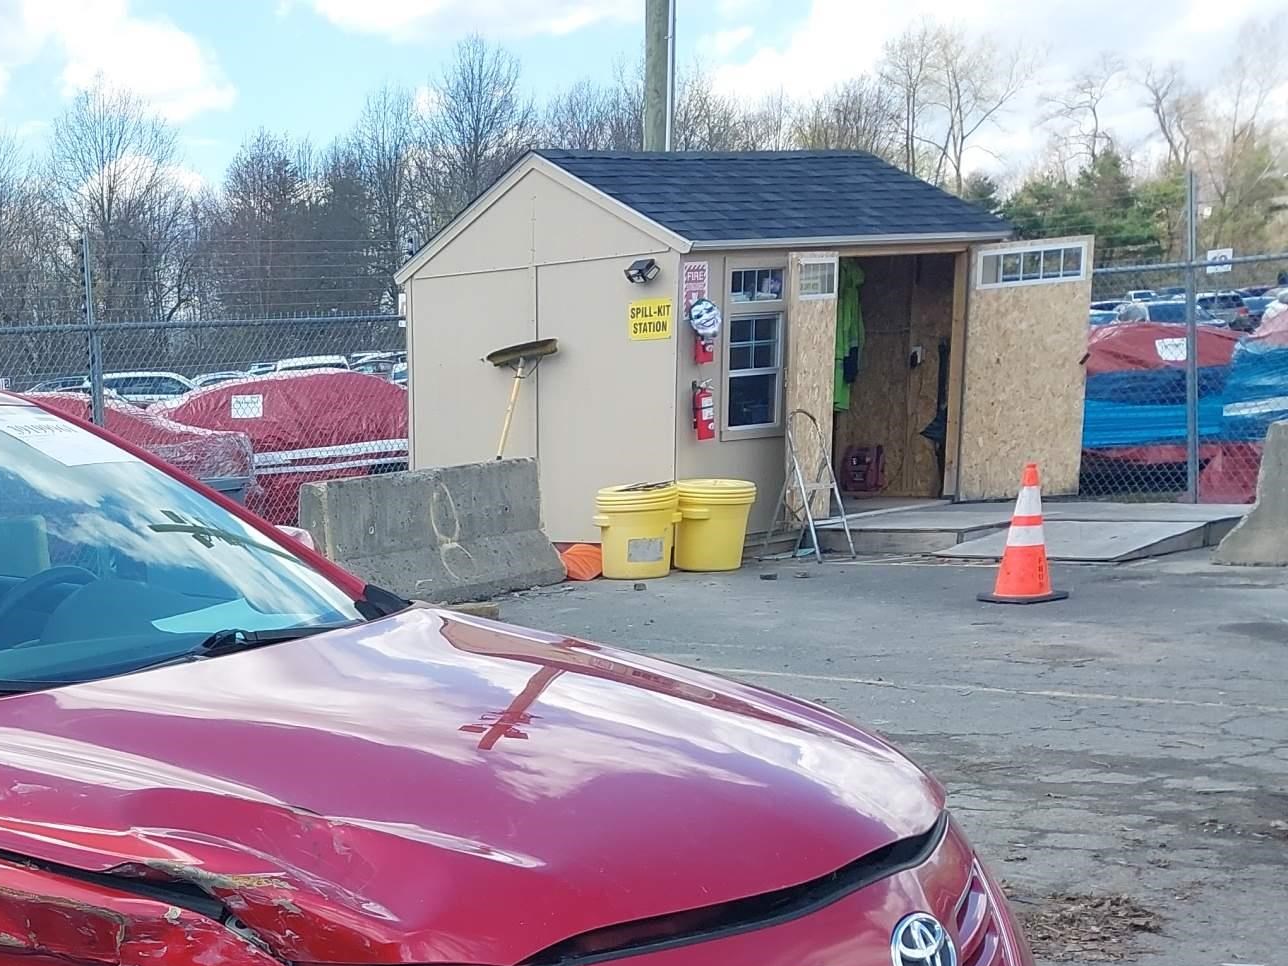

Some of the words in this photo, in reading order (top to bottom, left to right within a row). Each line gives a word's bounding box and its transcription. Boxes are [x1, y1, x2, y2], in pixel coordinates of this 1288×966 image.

[687, 271, 705, 281] FIRE
[630, 304, 672, 319] SPILL-KIT
[633, 320, 668, 335] STATION
